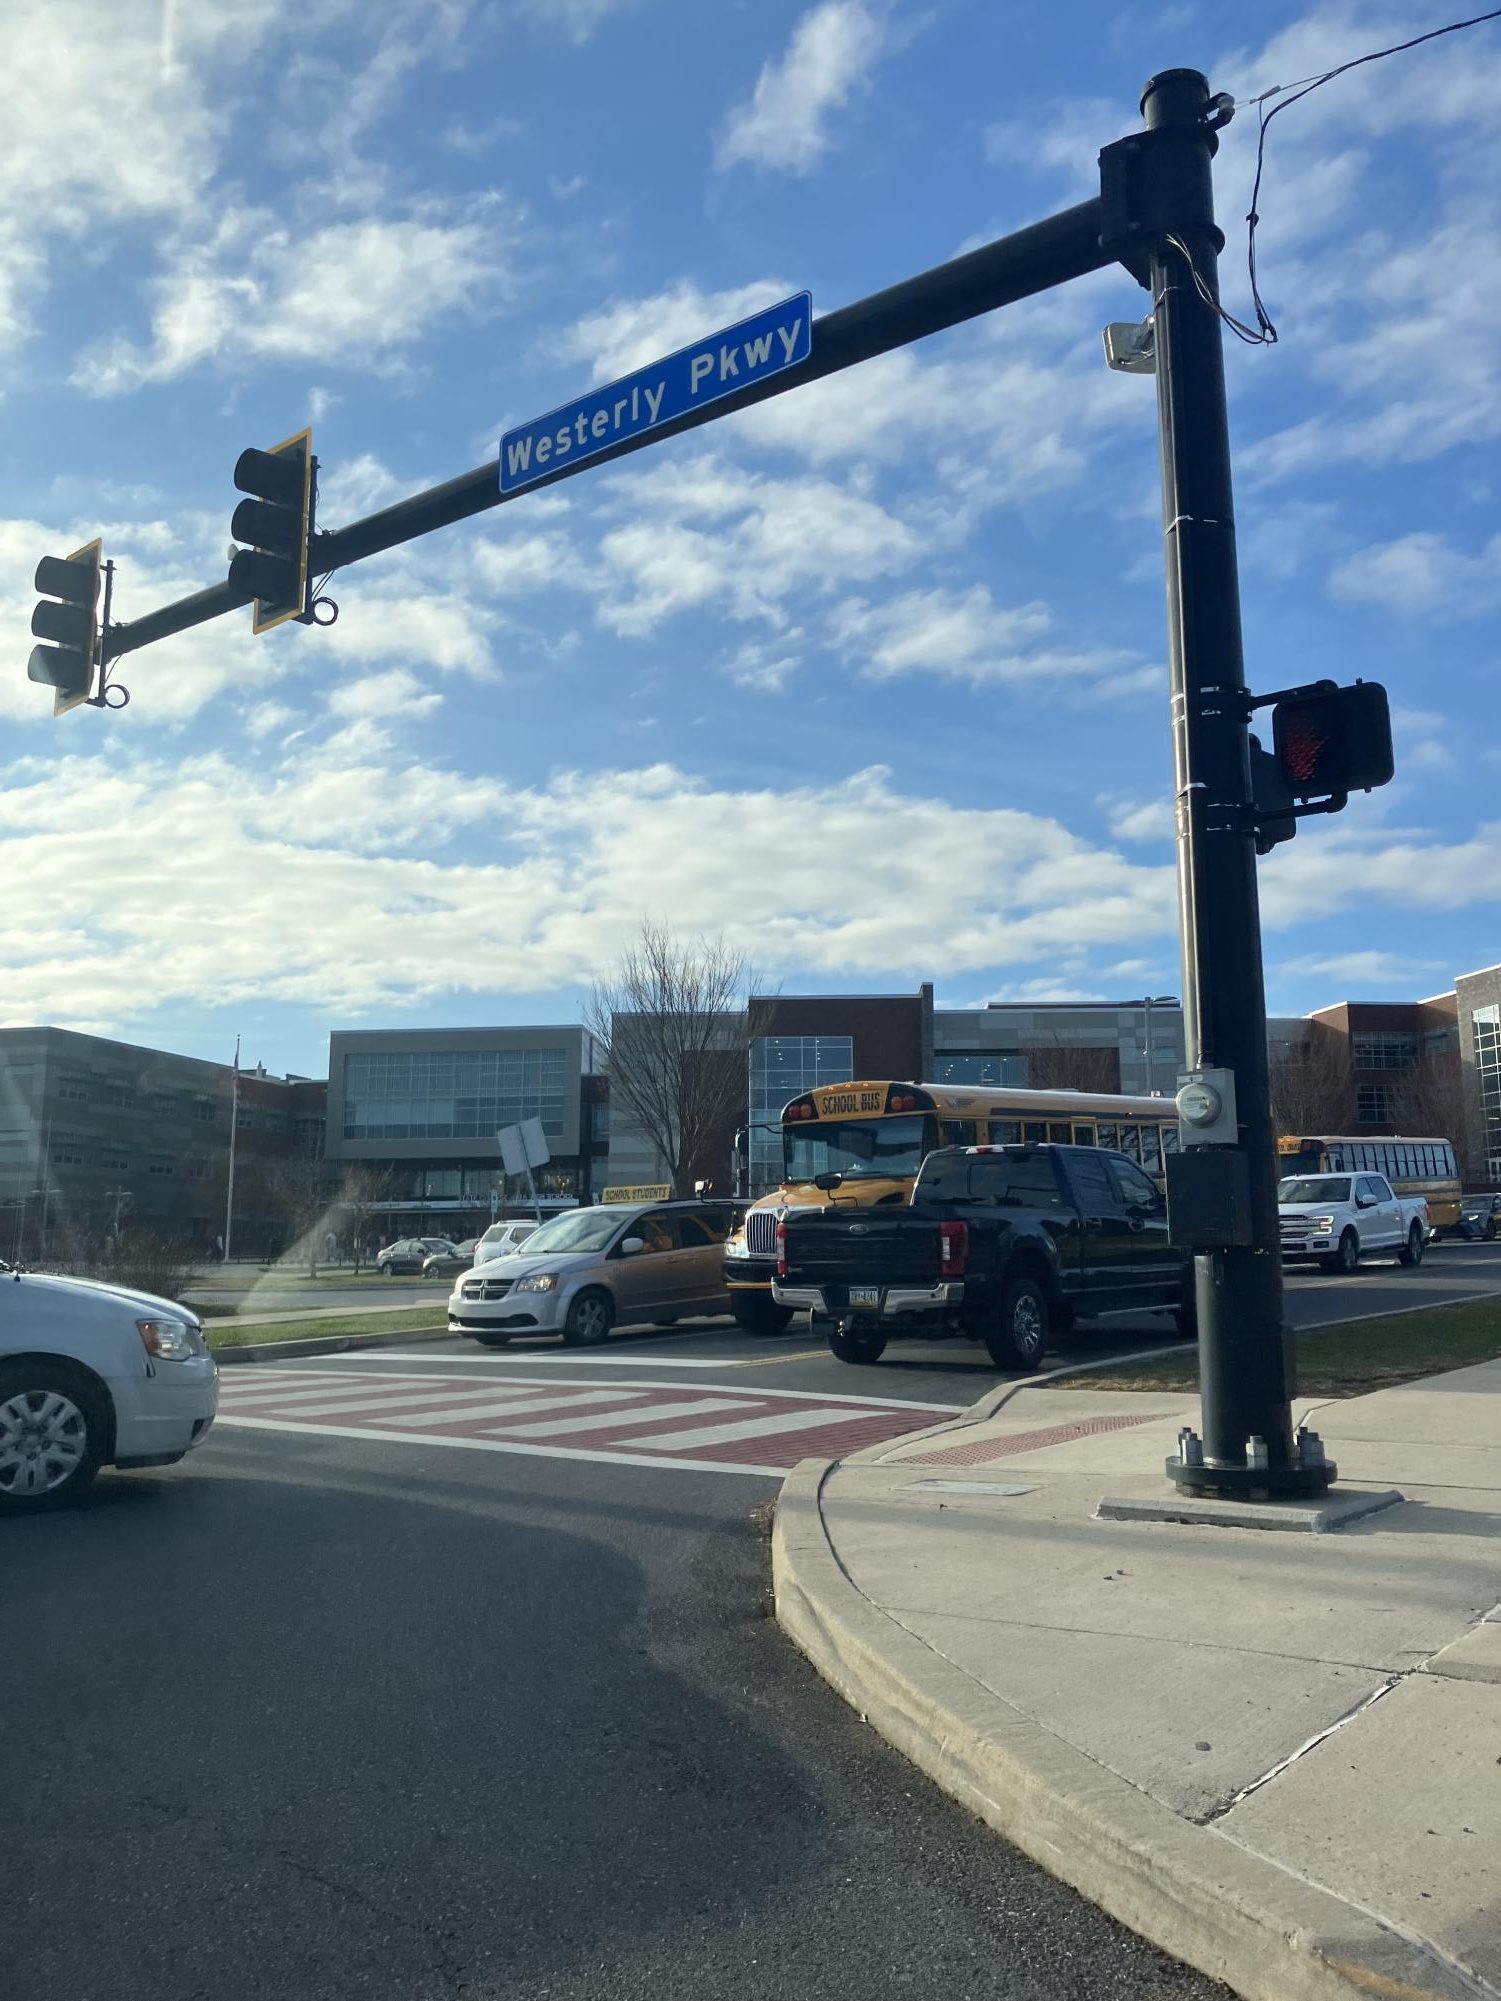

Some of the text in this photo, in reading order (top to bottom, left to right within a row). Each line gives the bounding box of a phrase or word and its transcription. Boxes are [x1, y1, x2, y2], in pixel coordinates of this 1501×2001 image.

[507, 317, 802, 477] Westerly Pkwy
[822, 1092, 881, 1115] SCHOOL BUS
[605, 1188, 631, 1201] SCHOOL
